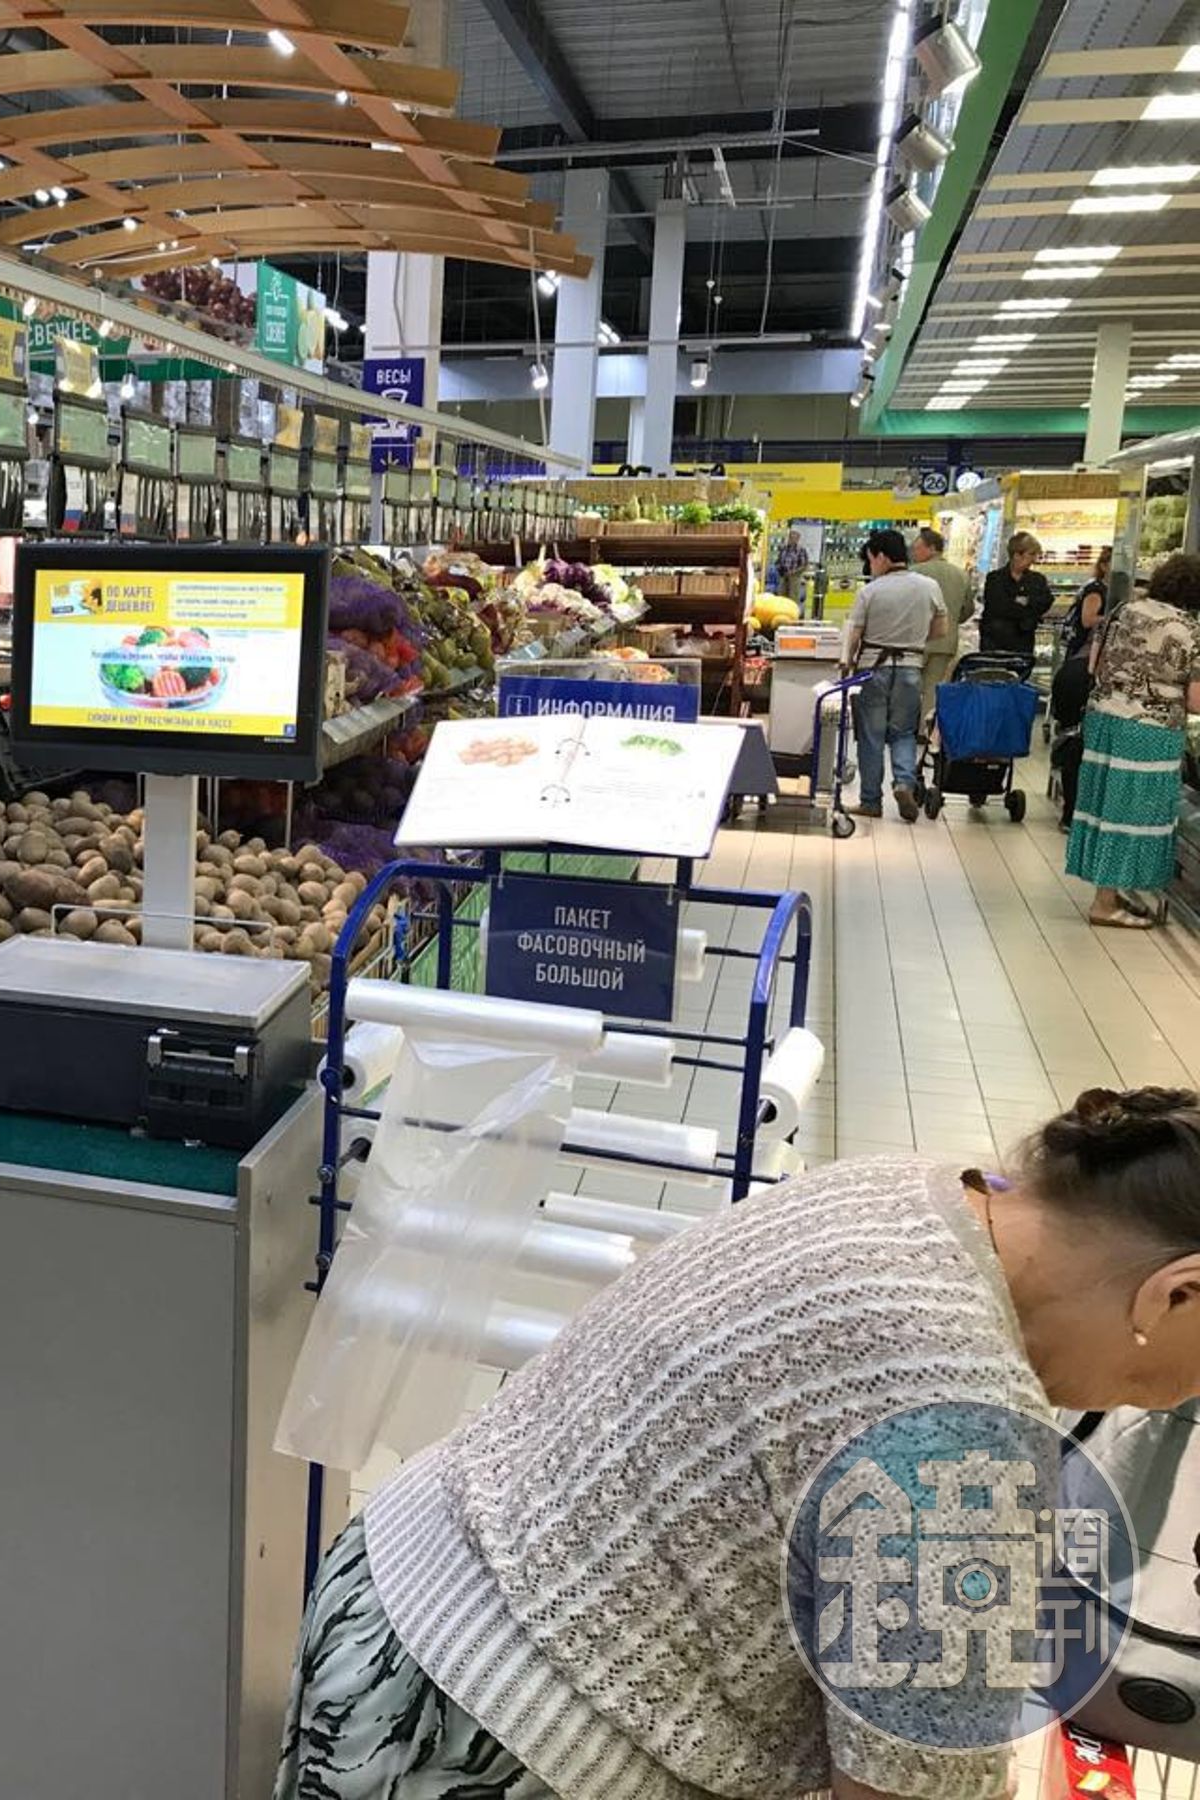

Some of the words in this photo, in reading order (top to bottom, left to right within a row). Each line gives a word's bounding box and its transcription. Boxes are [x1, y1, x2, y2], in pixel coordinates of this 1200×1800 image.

[376, 368, 412, 386] ВЕСЫ
[925, 476, 946, 490] 26
[537, 698, 676, 722] ИНФОРМАЦИЯ
[554, 906, 611, 930] ПАКЕТ
[517, 932, 647, 965] ФАСОВОЧНЫЙ
[535, 962, 624, 991] БОЛЬШОЙ
